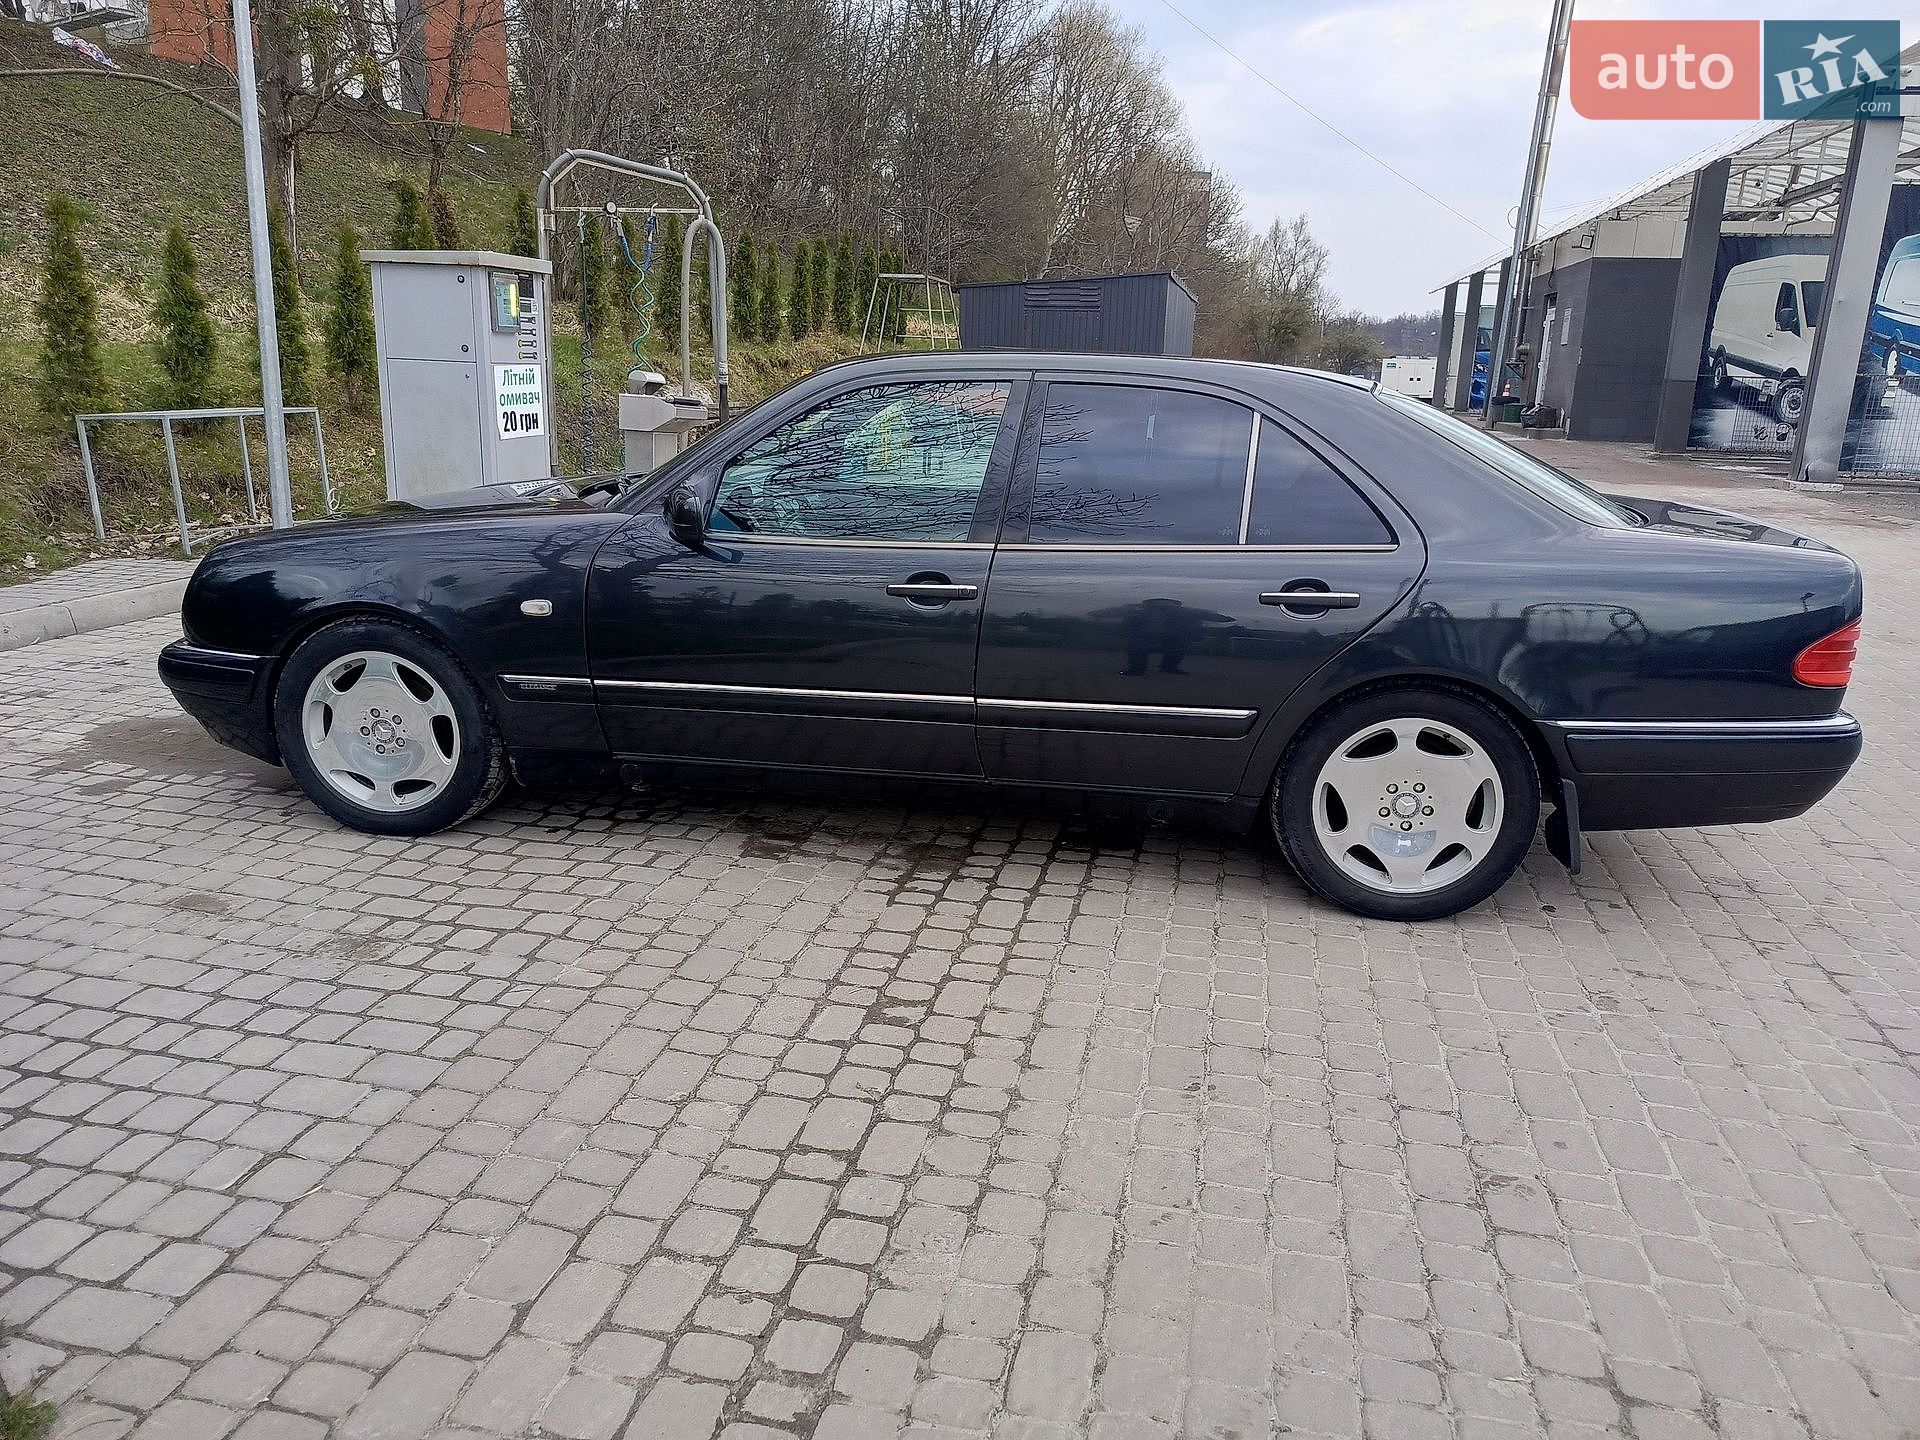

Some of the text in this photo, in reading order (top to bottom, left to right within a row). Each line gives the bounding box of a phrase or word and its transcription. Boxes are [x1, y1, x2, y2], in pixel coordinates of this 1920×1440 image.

[502, 368, 535, 387] Літній
[499, 391, 540, 407] омивач
[502, 410, 539, 432] 20 грн
